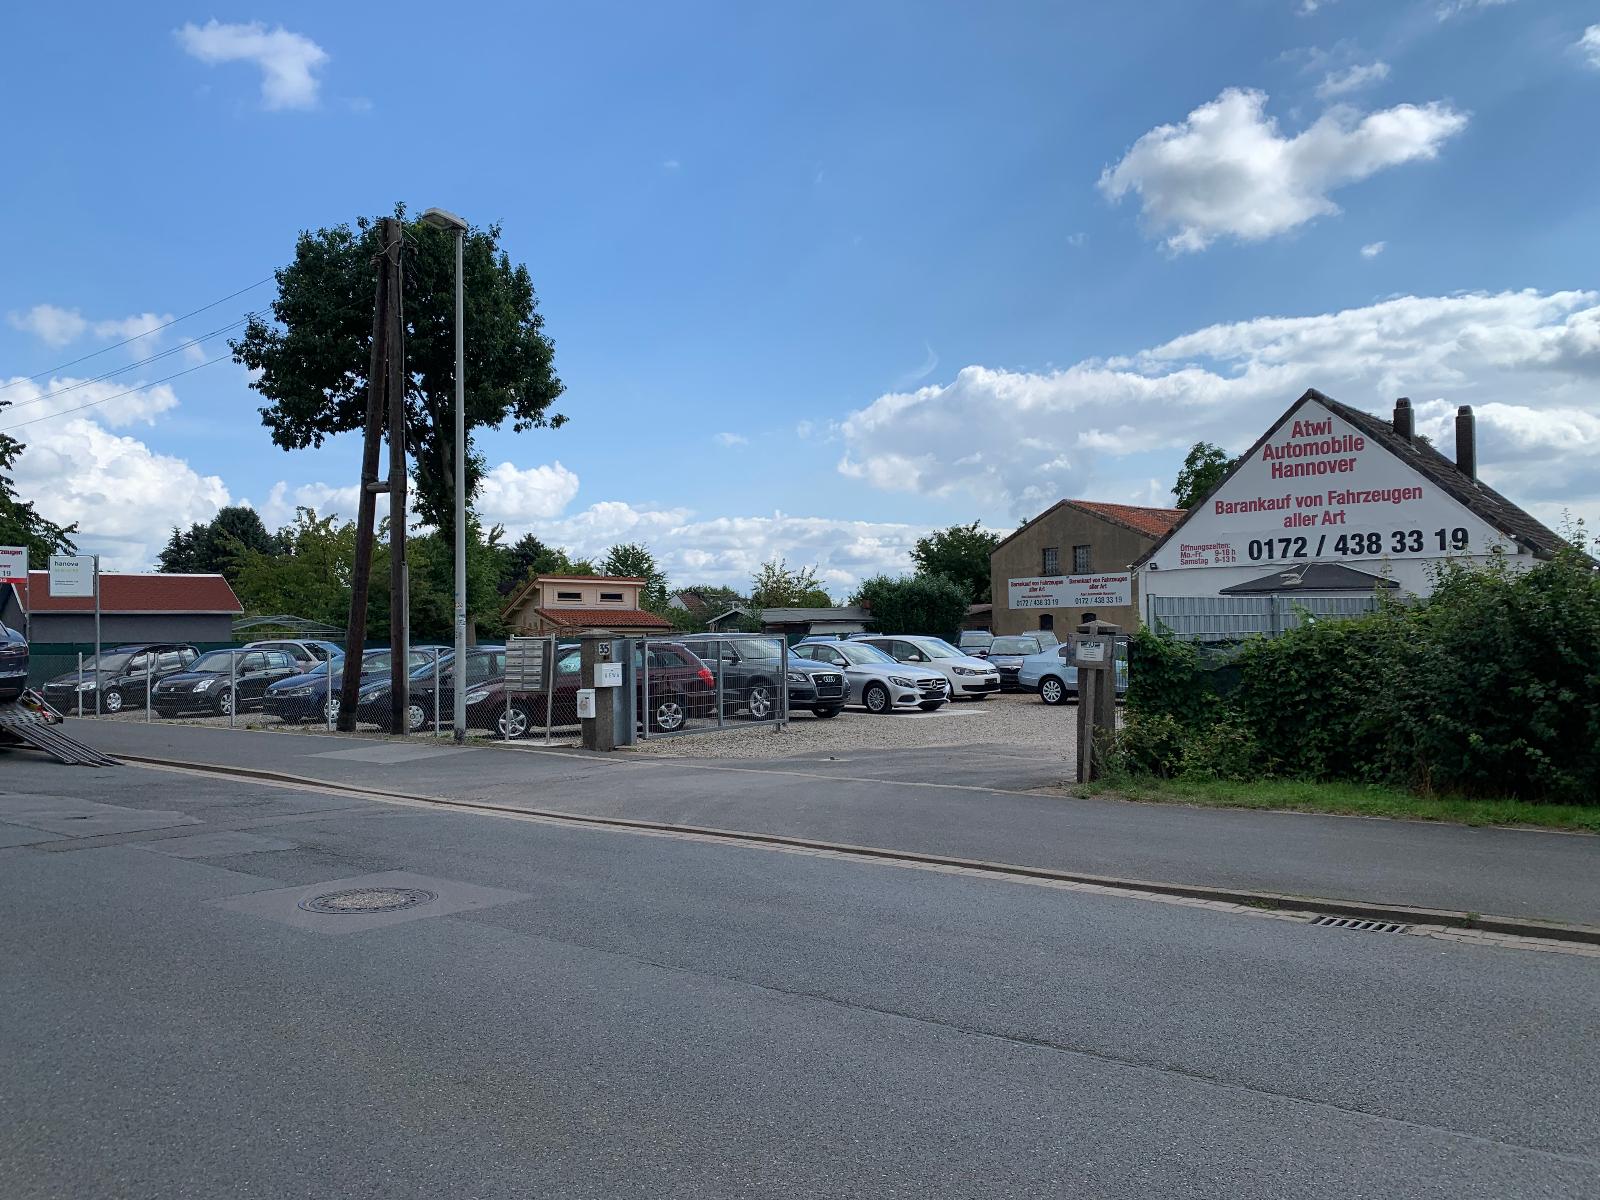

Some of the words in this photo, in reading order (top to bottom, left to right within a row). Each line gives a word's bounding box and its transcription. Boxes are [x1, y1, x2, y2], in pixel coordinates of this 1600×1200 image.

[1292, 417, 1332, 438] Atwi
[1263, 435, 1365, 461] Automobile
[1271, 458, 1357, 479] Hannover
[1215, 494, 1291, 514] Barankauf
[1295, 494, 1323, 508] von
[1327, 487, 1423, 505] Fahrzeugen
[1283, 513, 1318, 528] aller
[1321, 509, 1346, 525] Art
[1248, 537, 1308, 560] 0172
[1315, 535, 1326, 557] /
[1334, 532, 1382, 555] 438
[1391, 530, 1424, 553] 33
[1434, 528, 1469, 551] 19
[600, 643, 609, 654] 35
